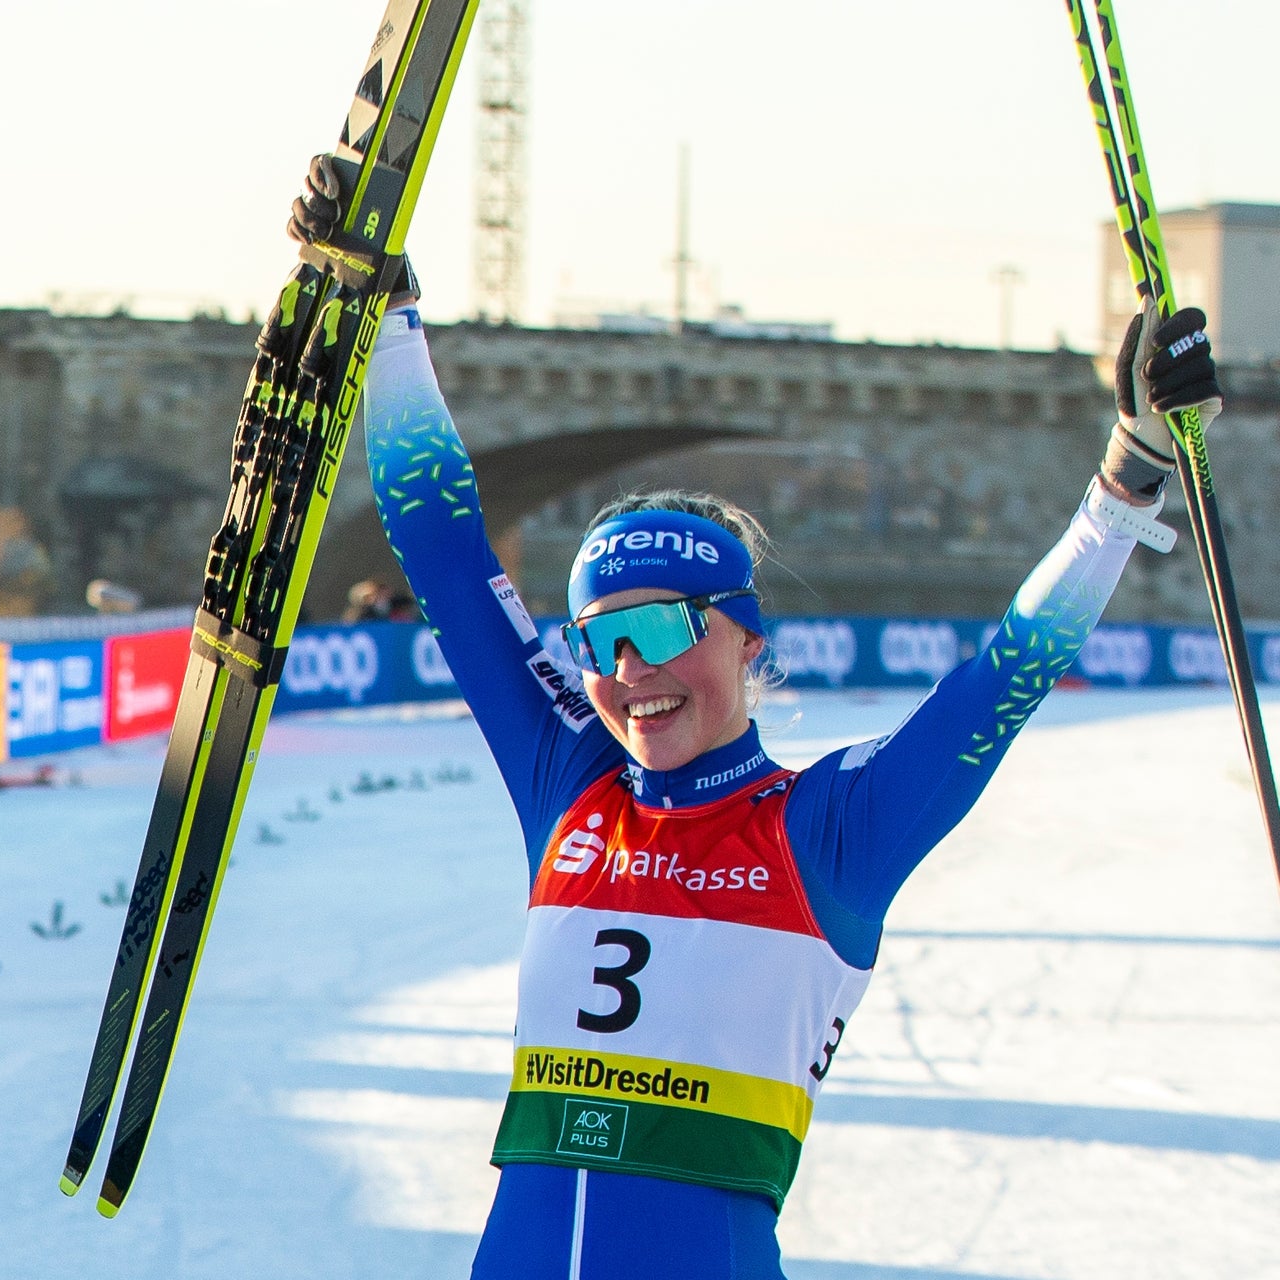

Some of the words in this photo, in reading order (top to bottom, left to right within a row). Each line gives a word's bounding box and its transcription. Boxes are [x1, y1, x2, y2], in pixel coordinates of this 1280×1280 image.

[316, 290, 389, 500] FISCHER
[194, 625, 263, 671] FISCHER
[695, 751, 765, 791] noname
[603, 845, 770, 893] parkasse
[576, 928, 652, 1034] 3
[526, 1053, 710, 1104] #VisitDresden
[569, 1132, 609, 1149] PLUS
[573, 1109, 613, 1131] AOK
